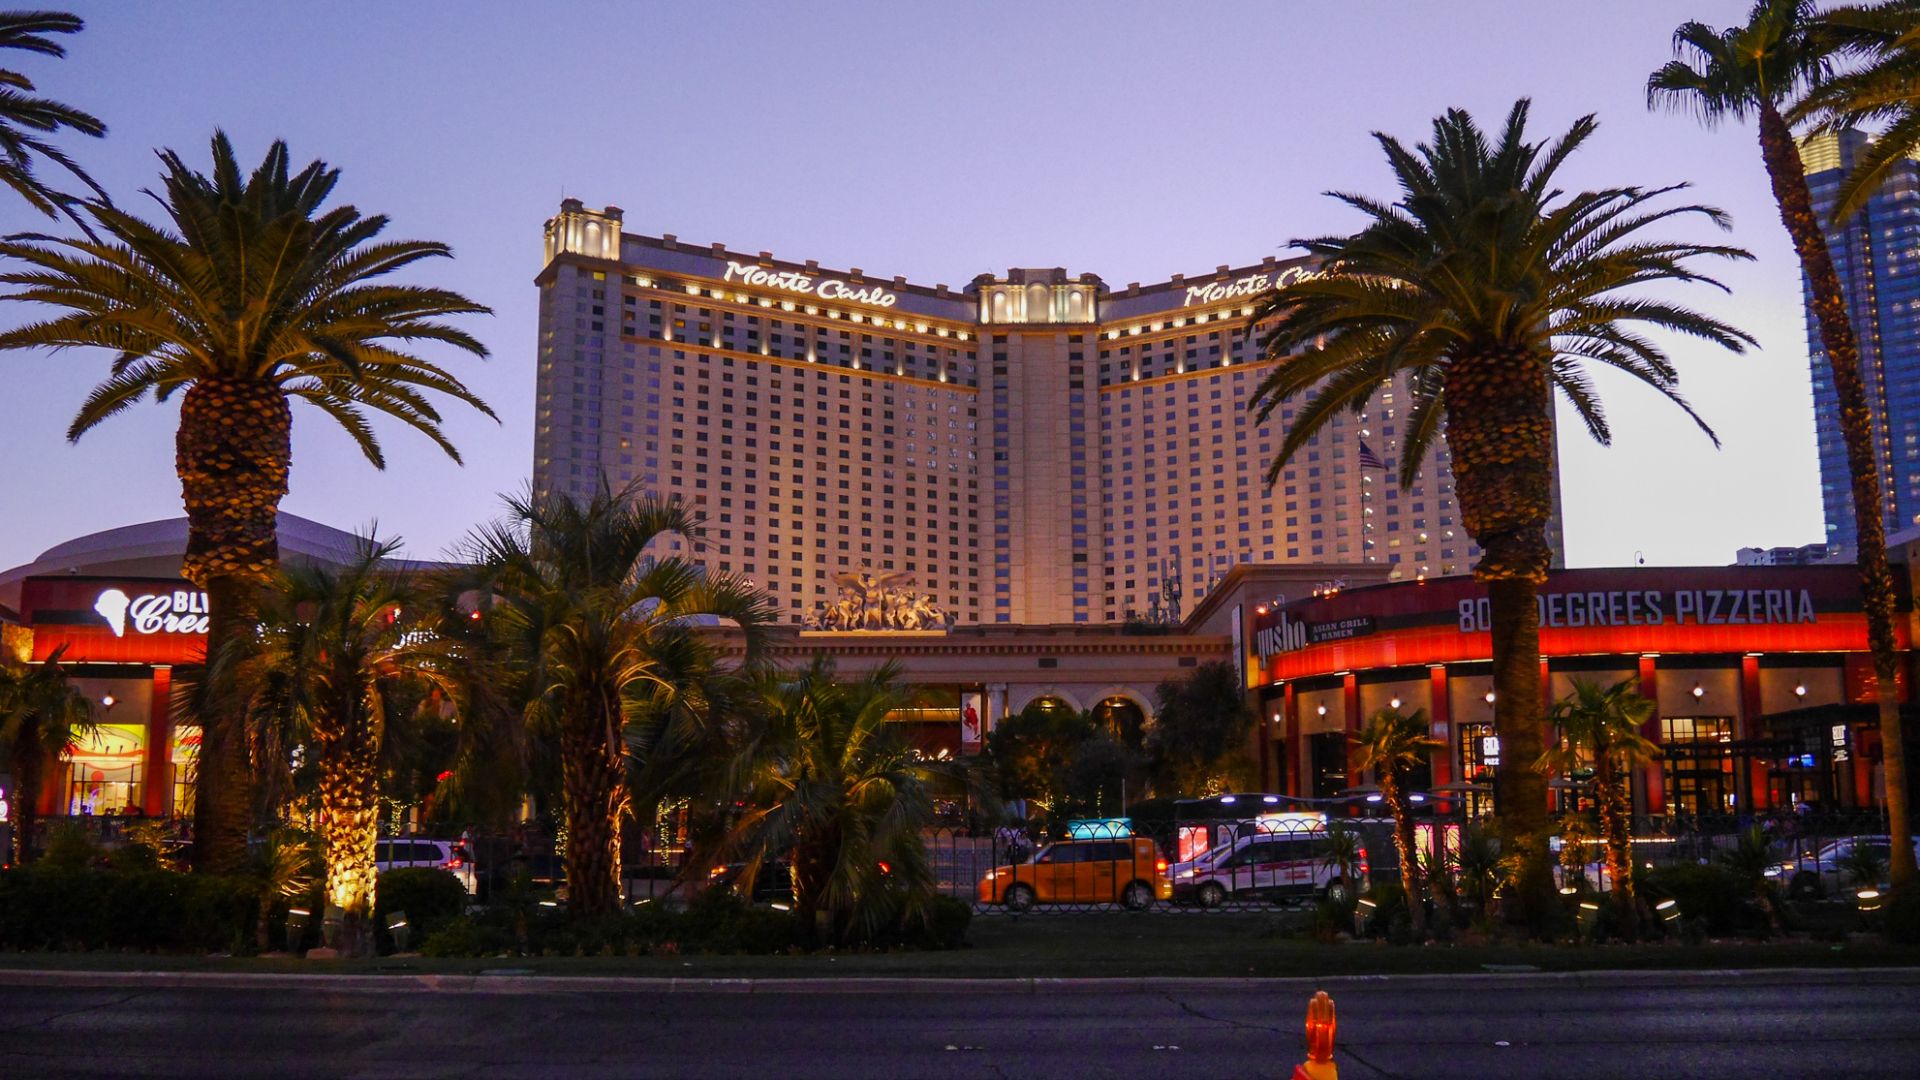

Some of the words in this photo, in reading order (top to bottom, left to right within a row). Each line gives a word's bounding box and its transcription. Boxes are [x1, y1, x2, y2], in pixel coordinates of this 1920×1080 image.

[724, 261, 814, 293] Monte
[817, 280, 896, 308] Carlo
[1184, 274, 1272, 307] Monte
[1675, 588, 1817, 625] PIZZERIA
[1312, 621, 1338, 634] ASIAN
[1340, 617, 1369, 629] GRILL
[1321, 629, 1354, 641] RAMEN
